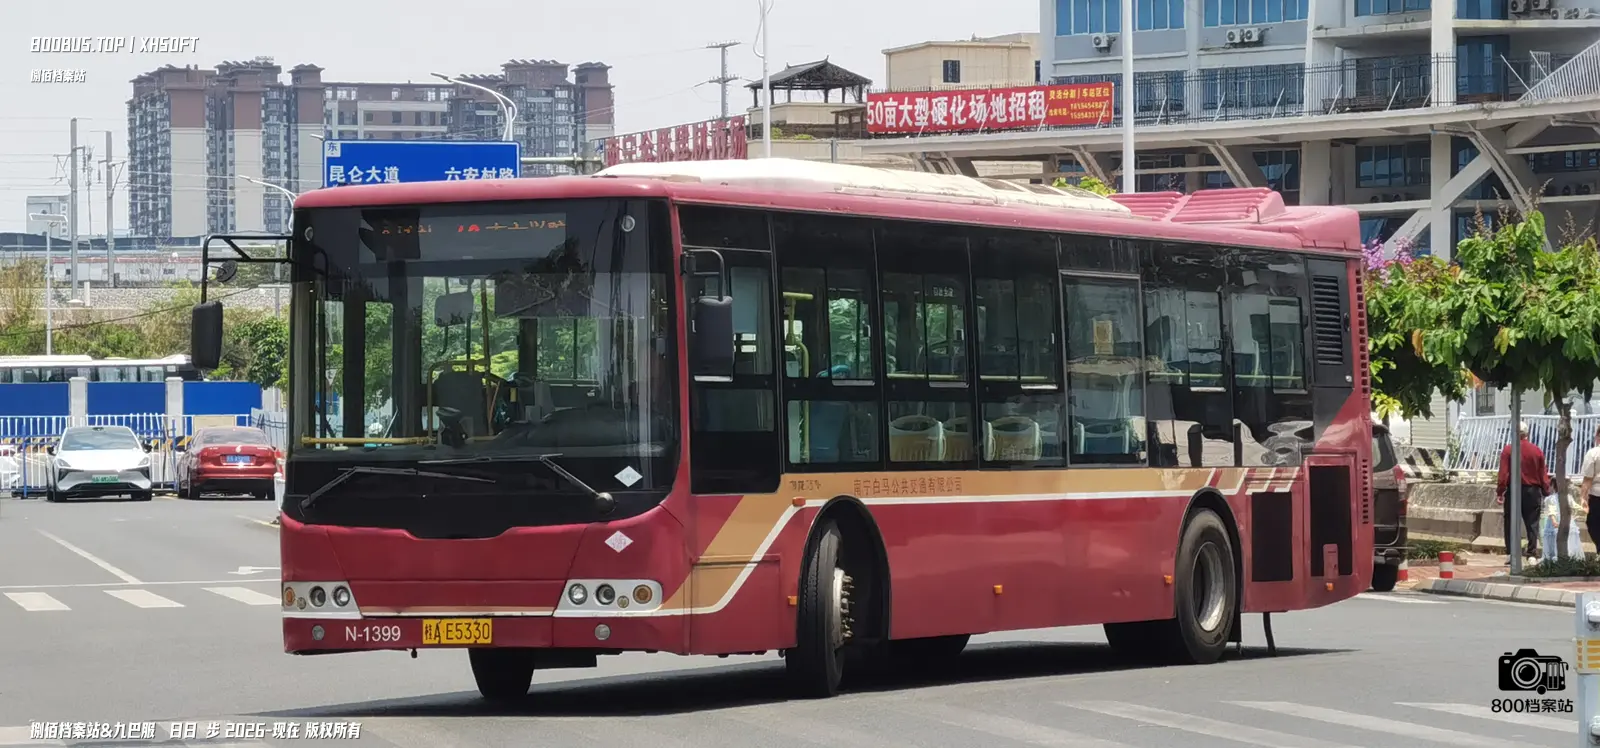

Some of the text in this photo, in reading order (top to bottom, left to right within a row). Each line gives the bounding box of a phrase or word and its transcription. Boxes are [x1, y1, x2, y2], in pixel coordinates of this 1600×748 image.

[867, 90, 1046, 128] 50亩大型硬化场地招租
[327, 142, 338, 152] 东
[329, 165, 515, 183] 昆仑大道 六安村路
[853, 476, 962, 496] 南宁白马公共交通有限公司
[345, 625, 401, 642] N-1399
